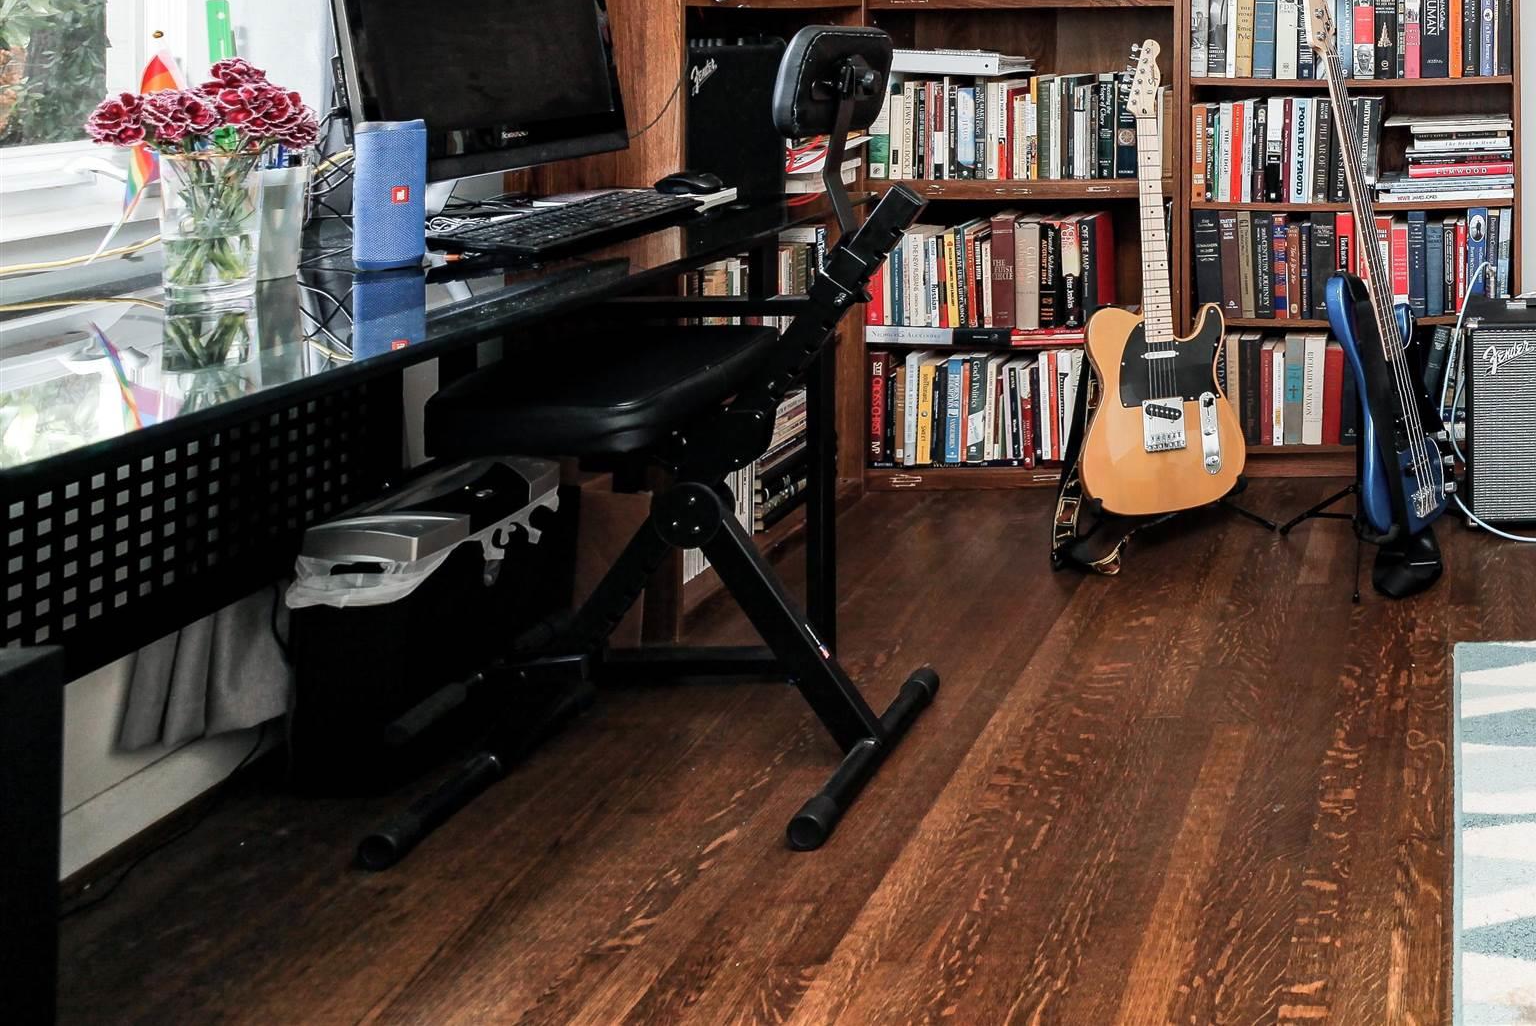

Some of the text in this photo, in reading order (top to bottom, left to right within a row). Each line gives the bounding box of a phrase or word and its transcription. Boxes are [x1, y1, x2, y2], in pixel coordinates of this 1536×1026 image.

[1237, 33, 1252, 41] Pyle
[1300, 49, 1313, 64] TIME
[691, 58, 718, 95] Fender
[1098, 109, 1106, 126] Glory
[1318, 122, 1328, 151] PILLAR
[1295, 107, 1306, 195] POOR BUT PROUD
[1317, 154, 1327, 166] OF
[1317, 169, 1327, 189] FIRE
[1435, 167, 1488, 175] ELMWOOD
[1081, 225, 1090, 239] OFF
[1081, 240, 1089, 253] THE
[912, 244, 920, 291] THE NEW RUSSIANS
[992, 272, 1014, 281] CIRCLE
[1260, 240, 1270, 306] CENTURY JOURNEY
[931, 284, 939, 310] Russian
[1066, 289, 1074, 309] Jenkins
[1483, 340, 1532, 375] Fender
[871, 377, 880, 407] CROSS
[970, 360, 981, 408] God's Politics
[871, 408, 880, 435] CHRIST
